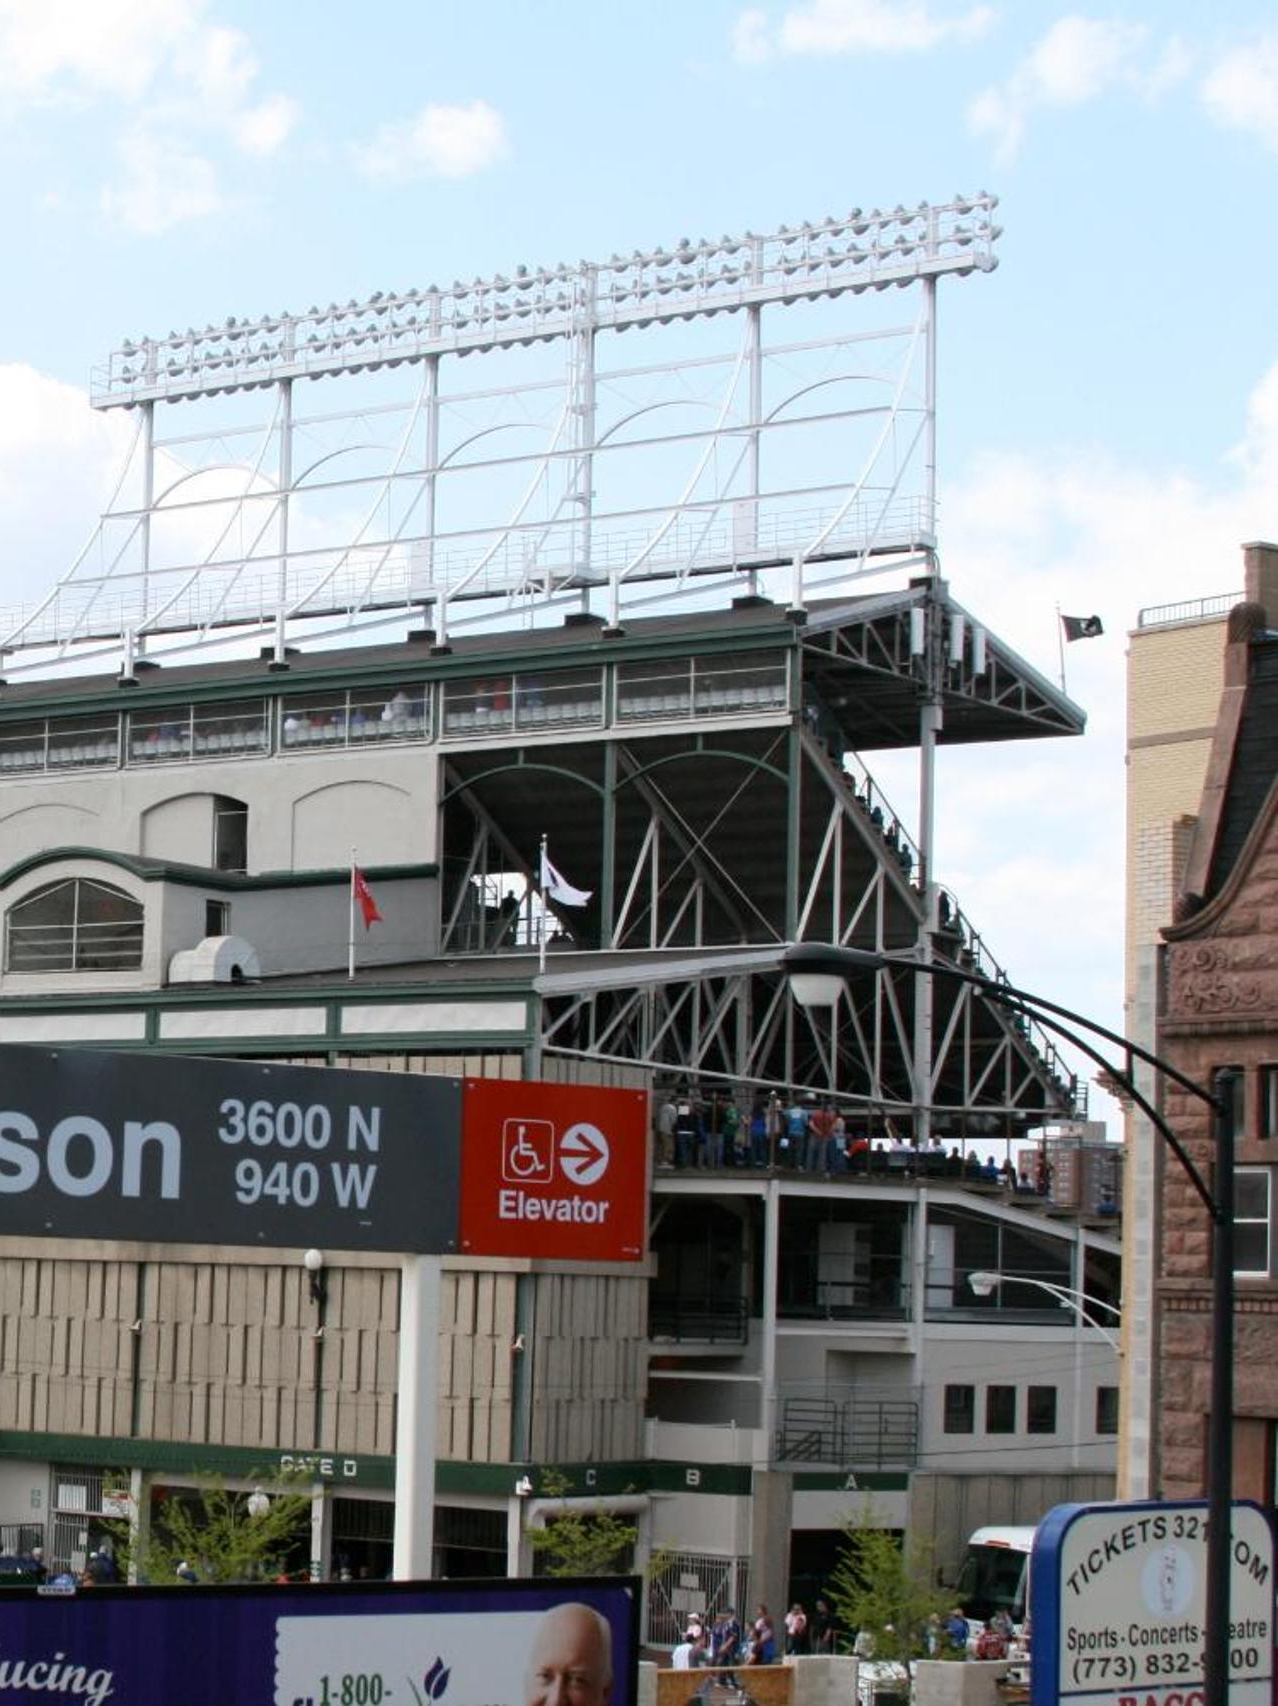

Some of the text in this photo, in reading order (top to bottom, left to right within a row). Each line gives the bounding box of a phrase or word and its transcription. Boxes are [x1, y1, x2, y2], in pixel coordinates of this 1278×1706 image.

[218, 1099, 382, 1152] 3600 N
[235, 1158, 378, 1209] 940 W
[498, 1188, 610, 1224] Elevator
[344, 1459, 357, 1477] D
[586, 1469, 597, 1486] C
[685, 1468, 701, 1486] B
[844, 1474, 858, 1489] A
[1066, 1515, 1168, 1596] TICKETS
[1067, 1617, 1268, 1655] Sports Concerts eatre
[1072, 1647, 1259, 1684] (773) 832-00
[320, 1673, 392, 1706] 1-800-
